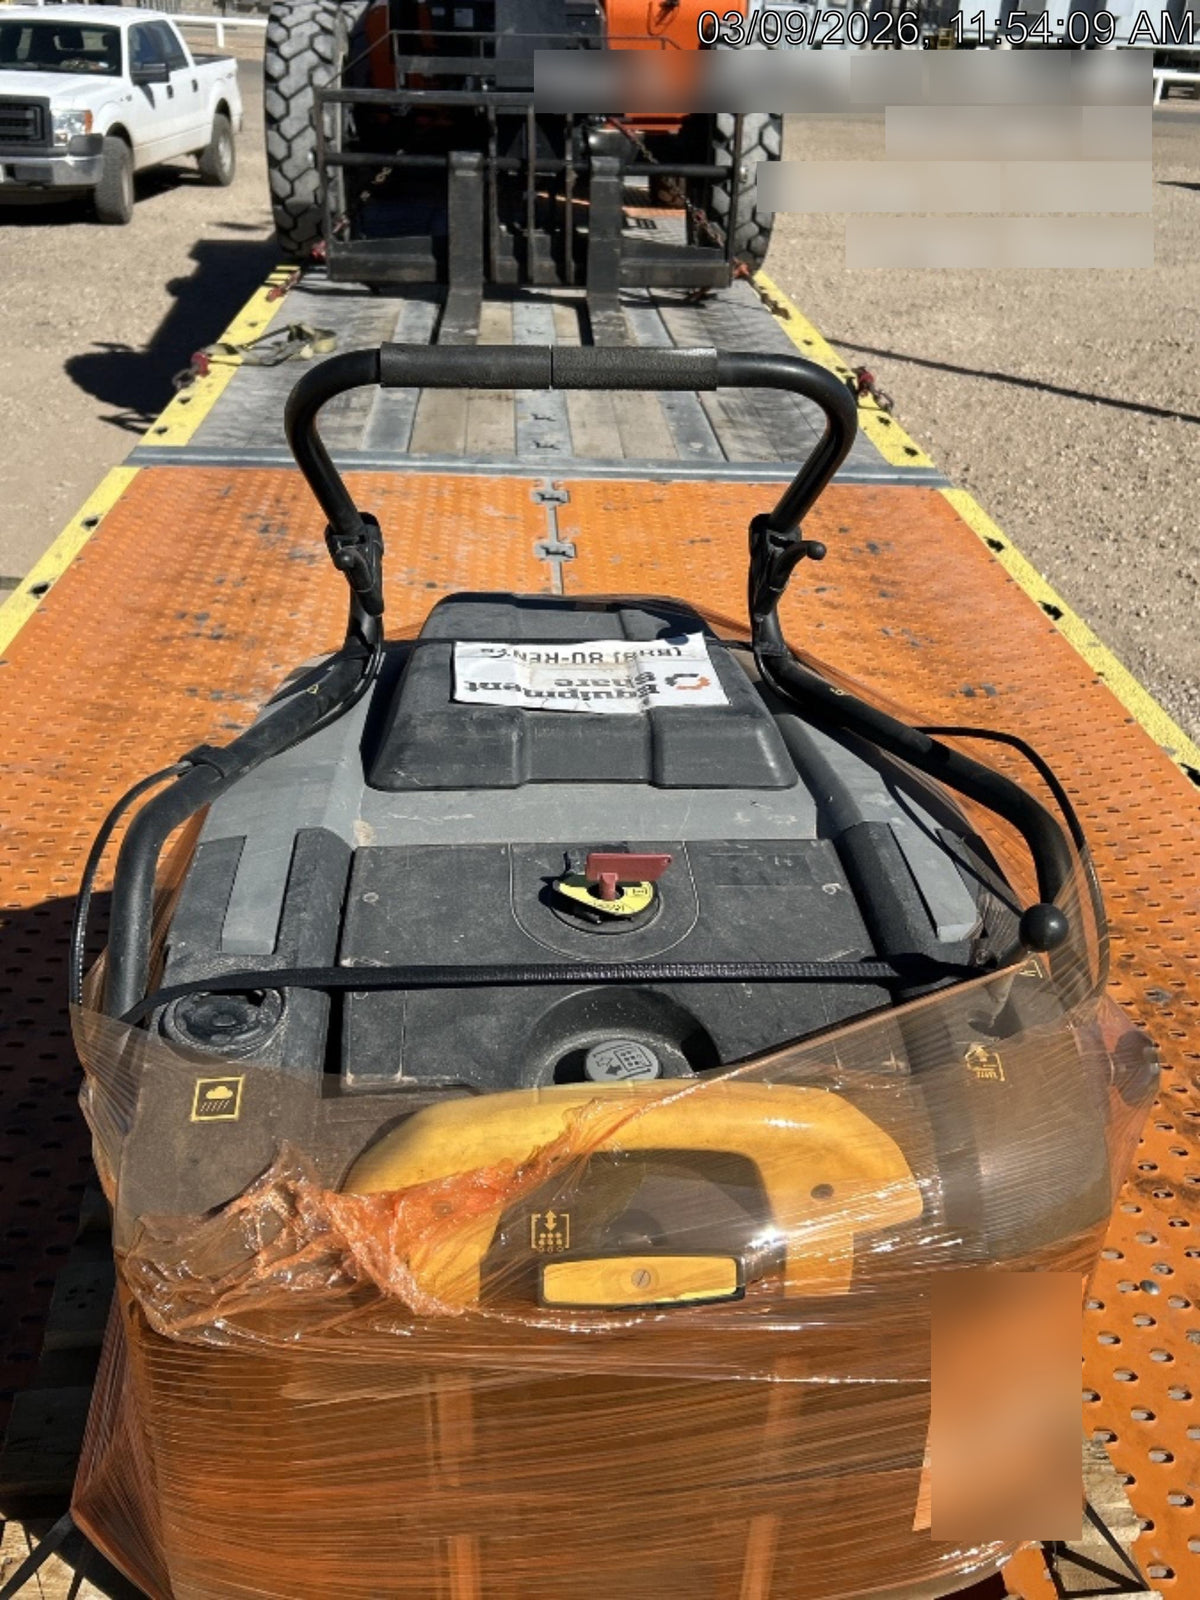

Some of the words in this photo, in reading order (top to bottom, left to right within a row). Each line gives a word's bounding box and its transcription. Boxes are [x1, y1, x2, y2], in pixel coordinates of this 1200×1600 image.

[480, 648, 604, 665] 80-REN
[553, 671, 656, 689] Share
[463, 680, 661, 701] Equipment
